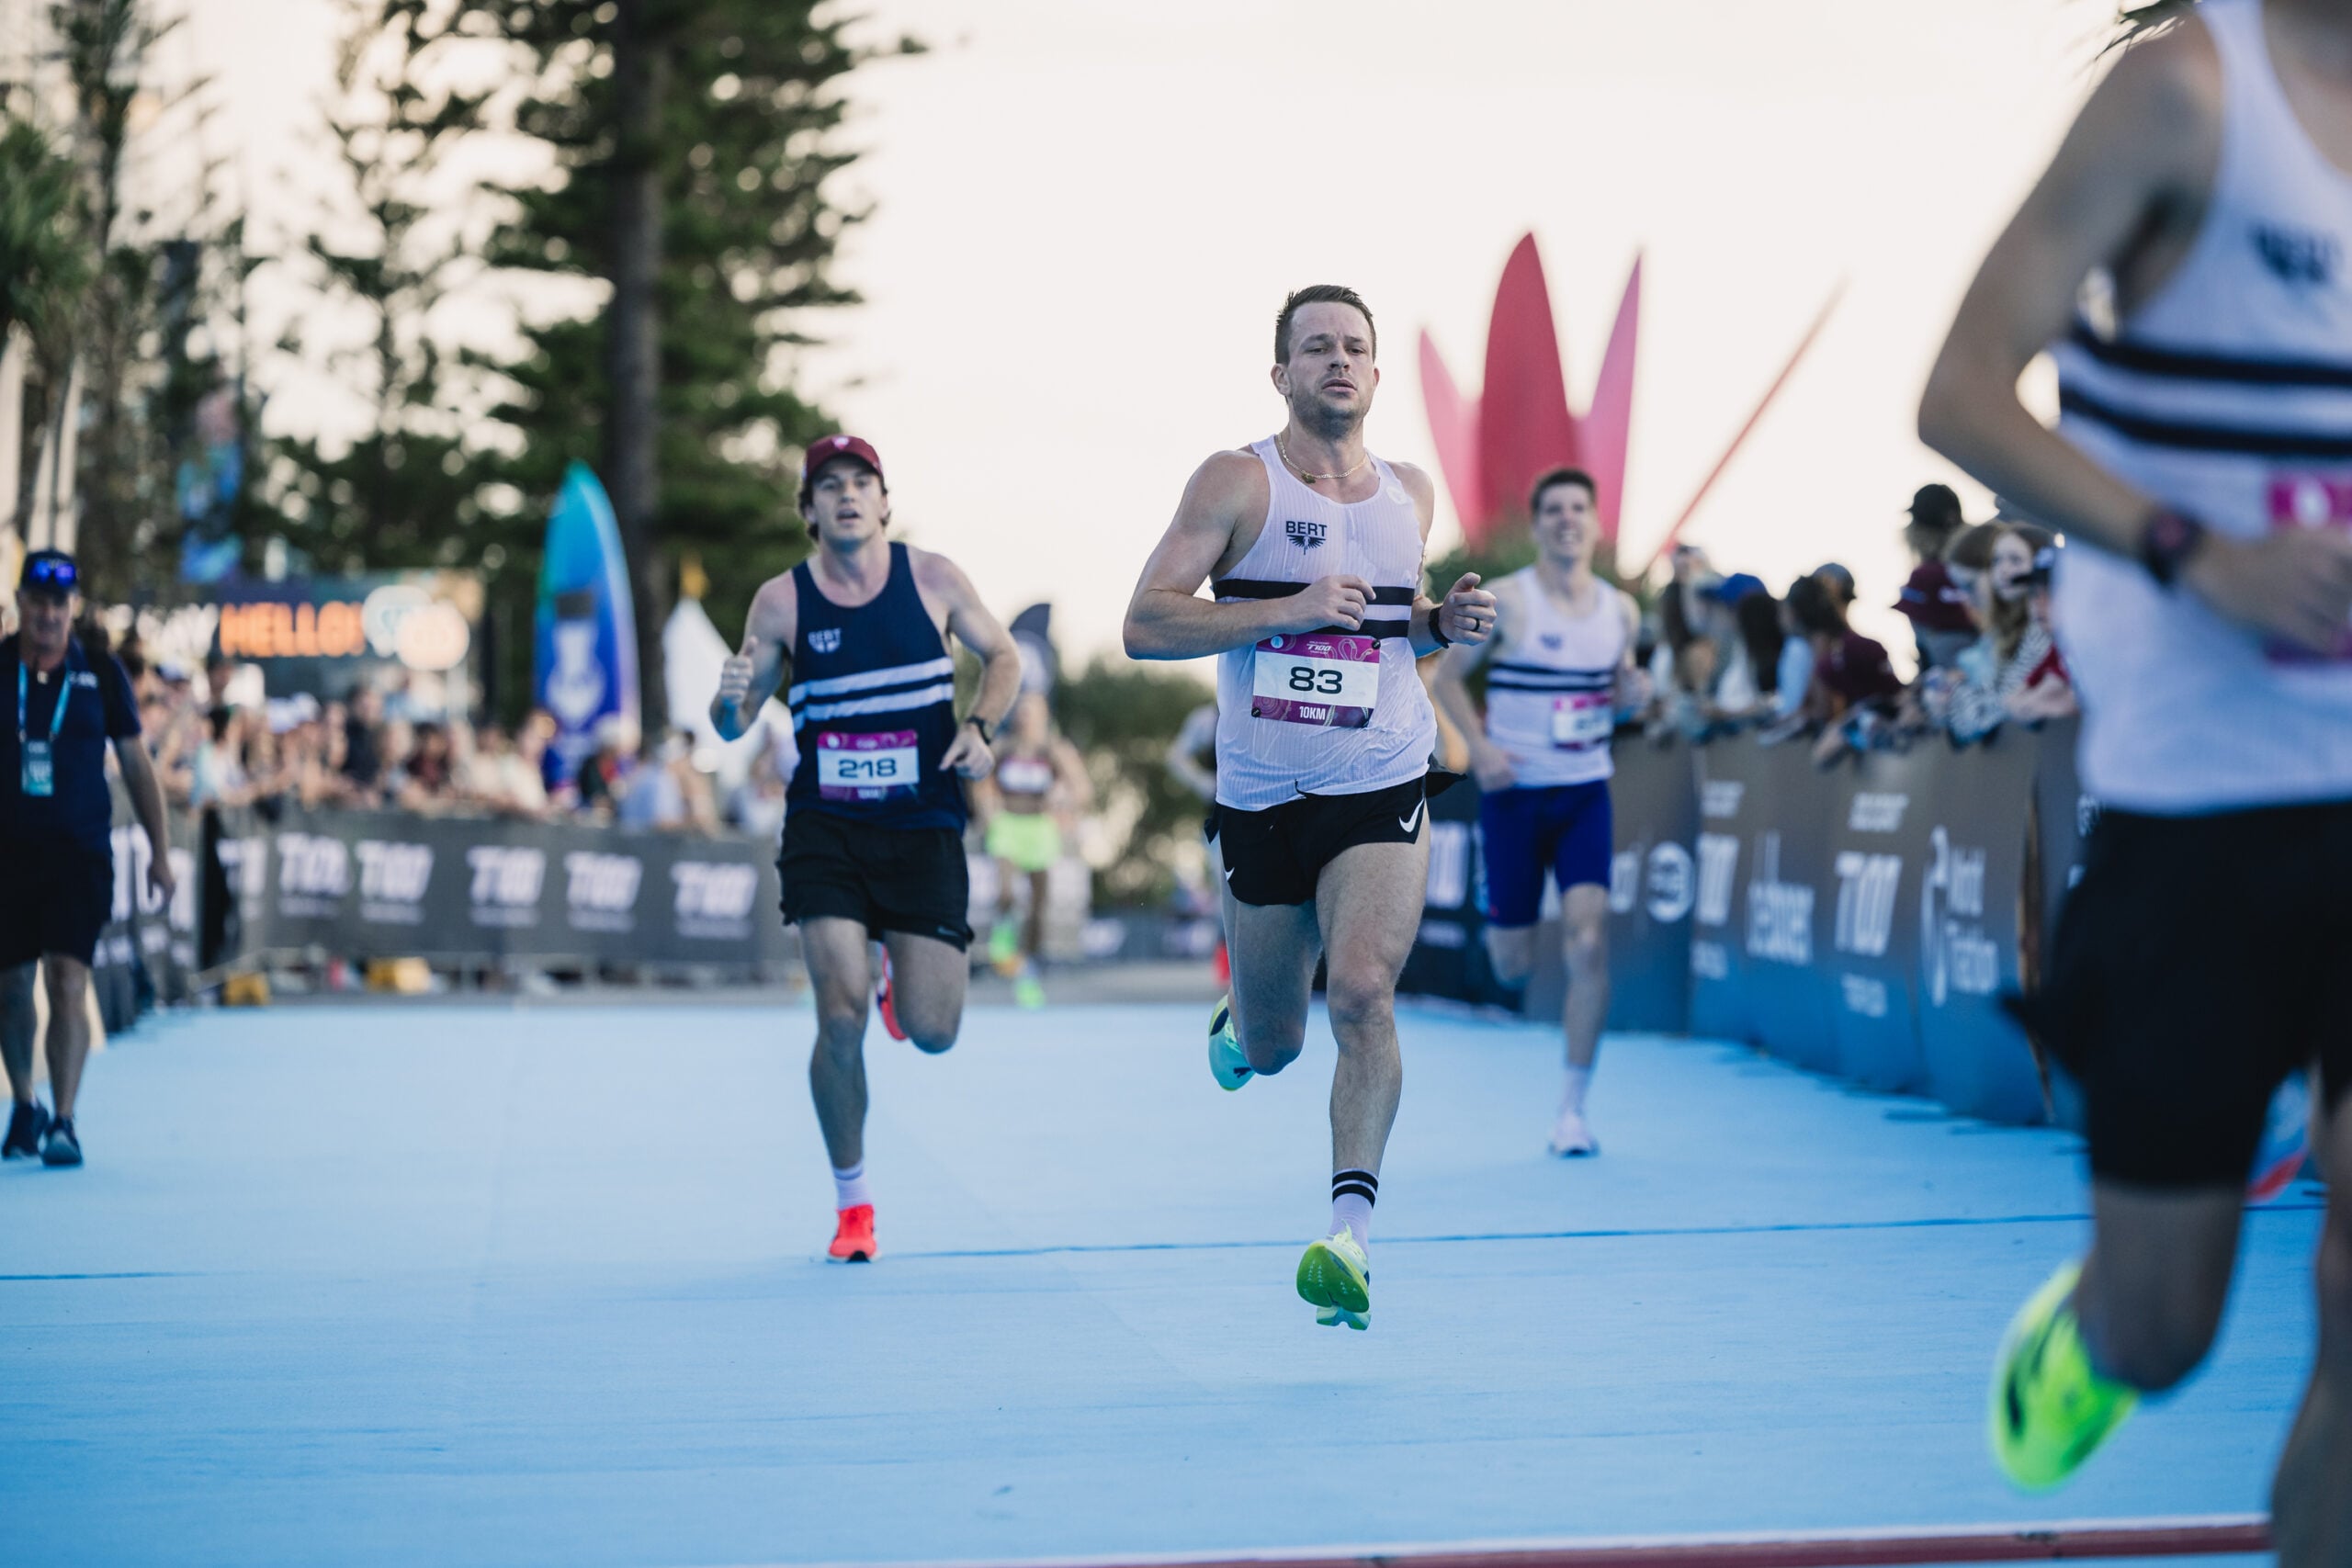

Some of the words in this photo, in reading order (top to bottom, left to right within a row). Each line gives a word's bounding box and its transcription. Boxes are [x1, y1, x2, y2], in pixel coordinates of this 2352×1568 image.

[1285, 520, 1328, 537] BERT
[1288, 666, 1343, 694] 83
[1299, 705, 1327, 720] 10KM
[838, 758, 897, 778] 218
